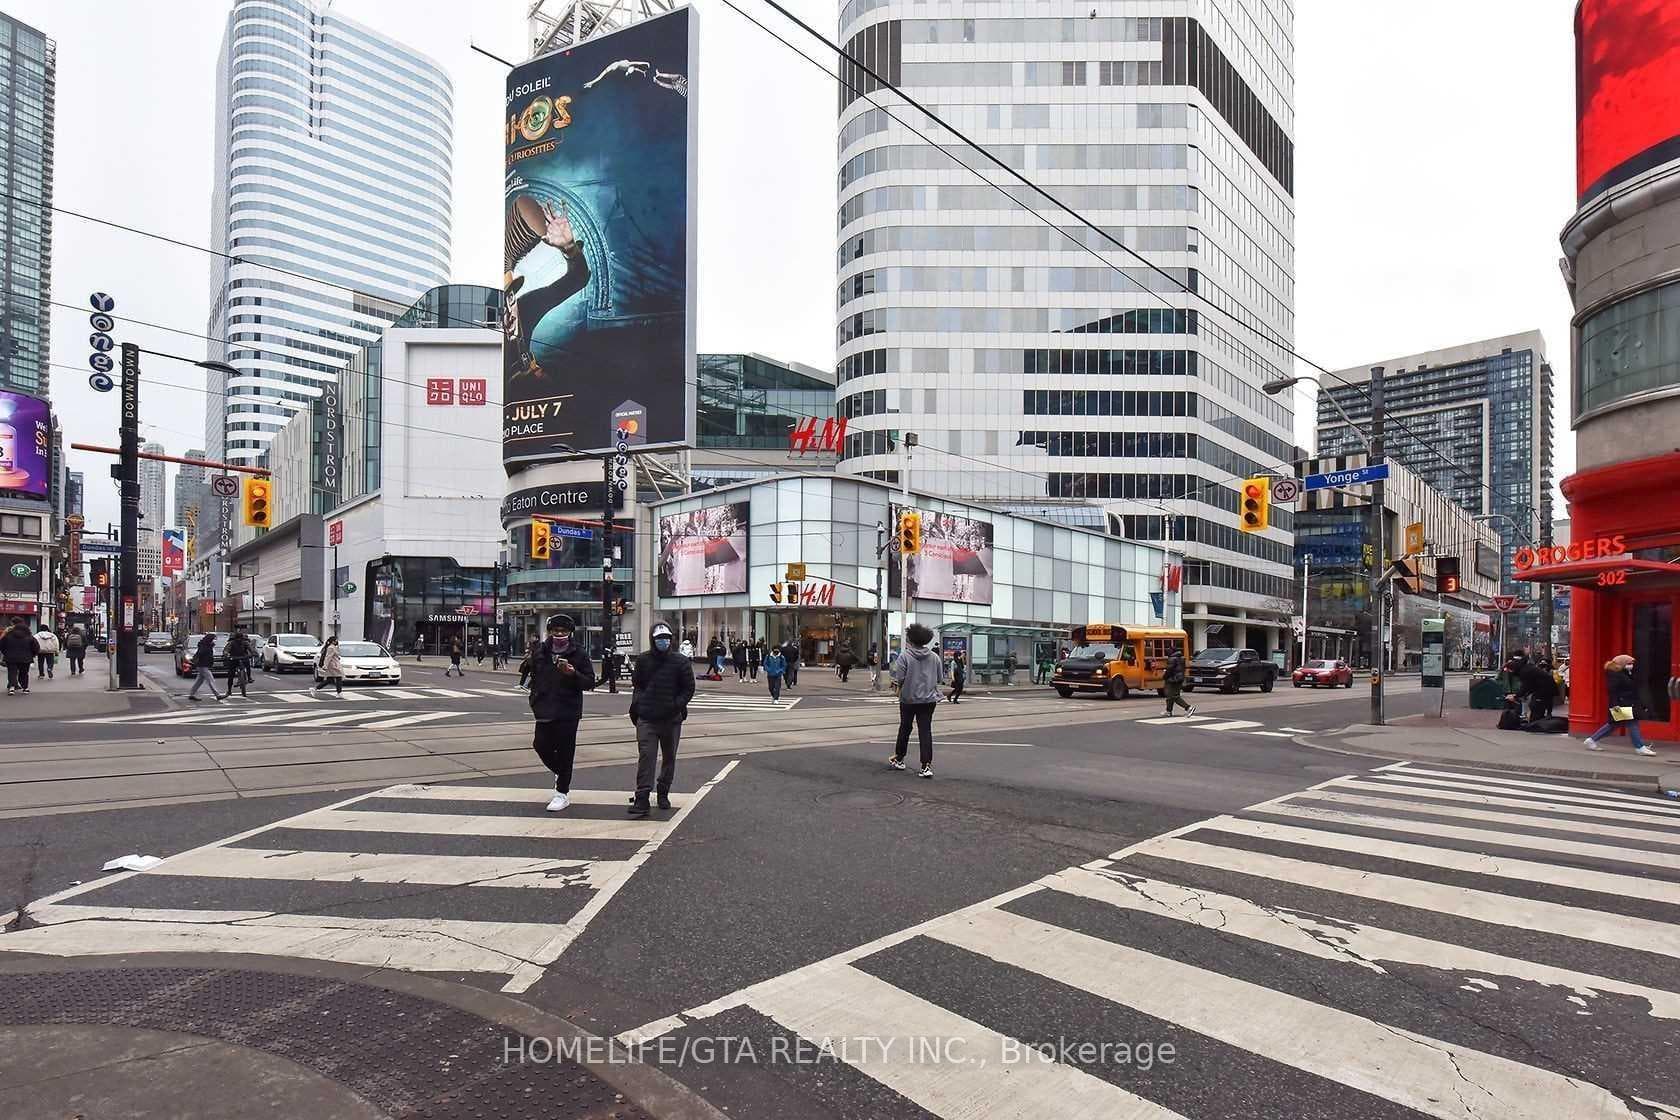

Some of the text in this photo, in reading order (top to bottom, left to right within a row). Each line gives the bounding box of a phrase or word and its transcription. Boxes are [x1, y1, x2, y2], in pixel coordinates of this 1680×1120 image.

[515, 77, 551, 97] SOLEIL
[125, 350, 135, 418] DOWNTOWN
[512, 401, 562, 421] JULY 7
[325, 385, 337, 487] NORDSTROM
[511, 422, 544, 436] PLACE
[789, 416, 848, 456] H&M
[1324, 471, 1360, 484] Yonge
[512, 495, 538, 512] Eaton
[540, 490, 589, 504] Centre
[557, 527, 581, 536] Dundas
[1537, 536, 1626, 565] ROGERS
[1447, 578, 1456, 591] 3
[1597, 570, 1626, 586] 302
[800, 583, 836, 607] H&M
